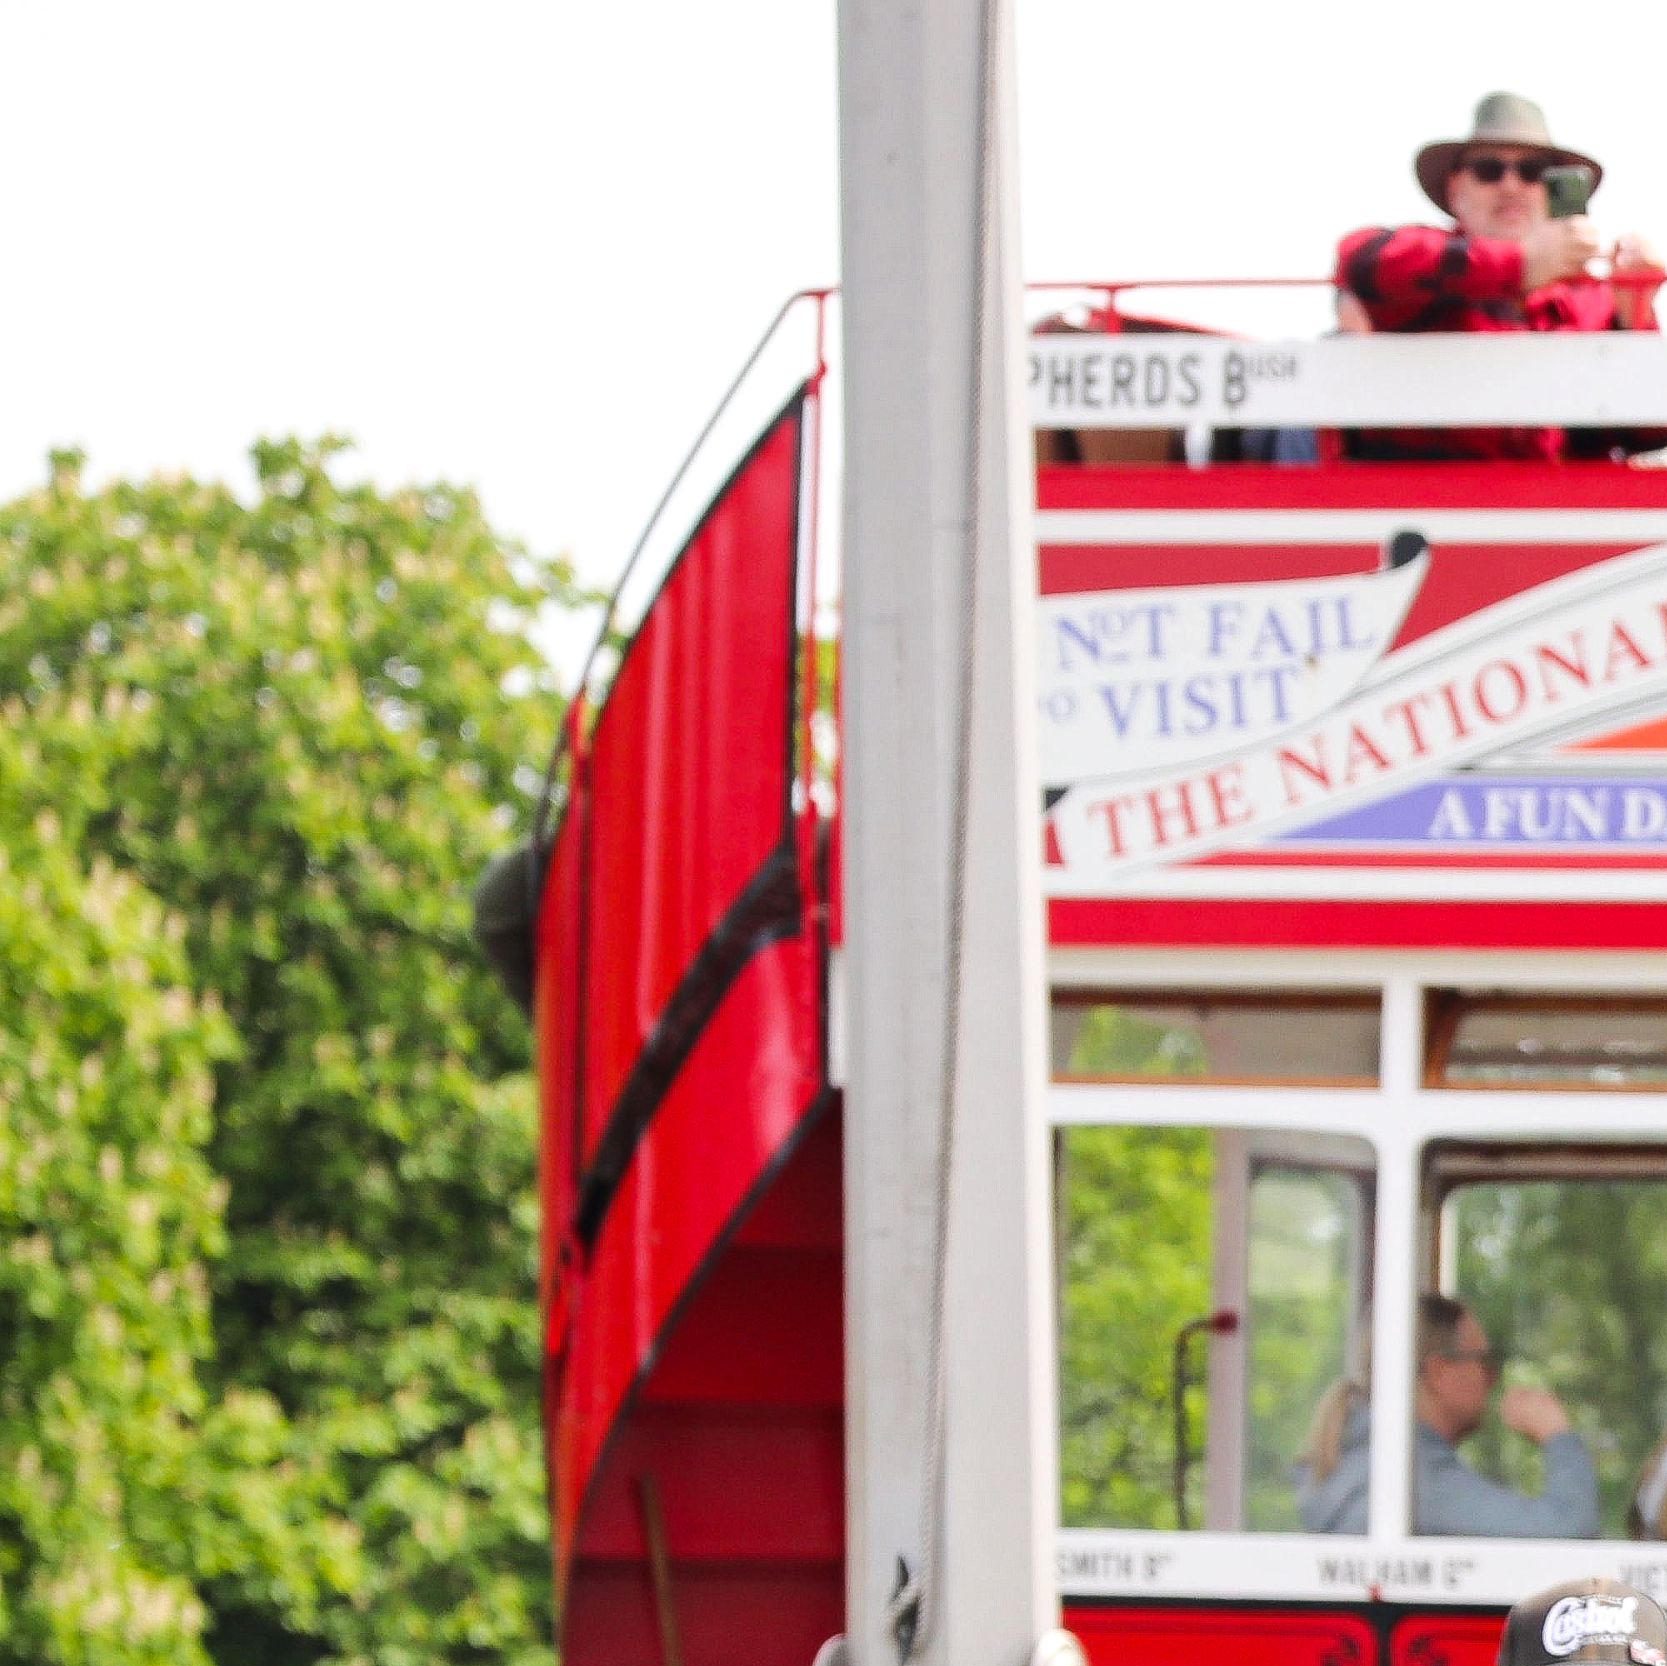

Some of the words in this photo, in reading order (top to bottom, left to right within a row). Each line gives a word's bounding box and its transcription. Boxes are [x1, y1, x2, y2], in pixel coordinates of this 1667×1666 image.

[1207, 596, 1376, 659] FAIL
[1098, 667, 1300, 741] VISIT
[1088, 763, 1254, 860] THE
[1427, 789, 1474, 841] A
[1483, 788, 1613, 842] FUN
[1542, 1596, 1638, 1656] Castrol
